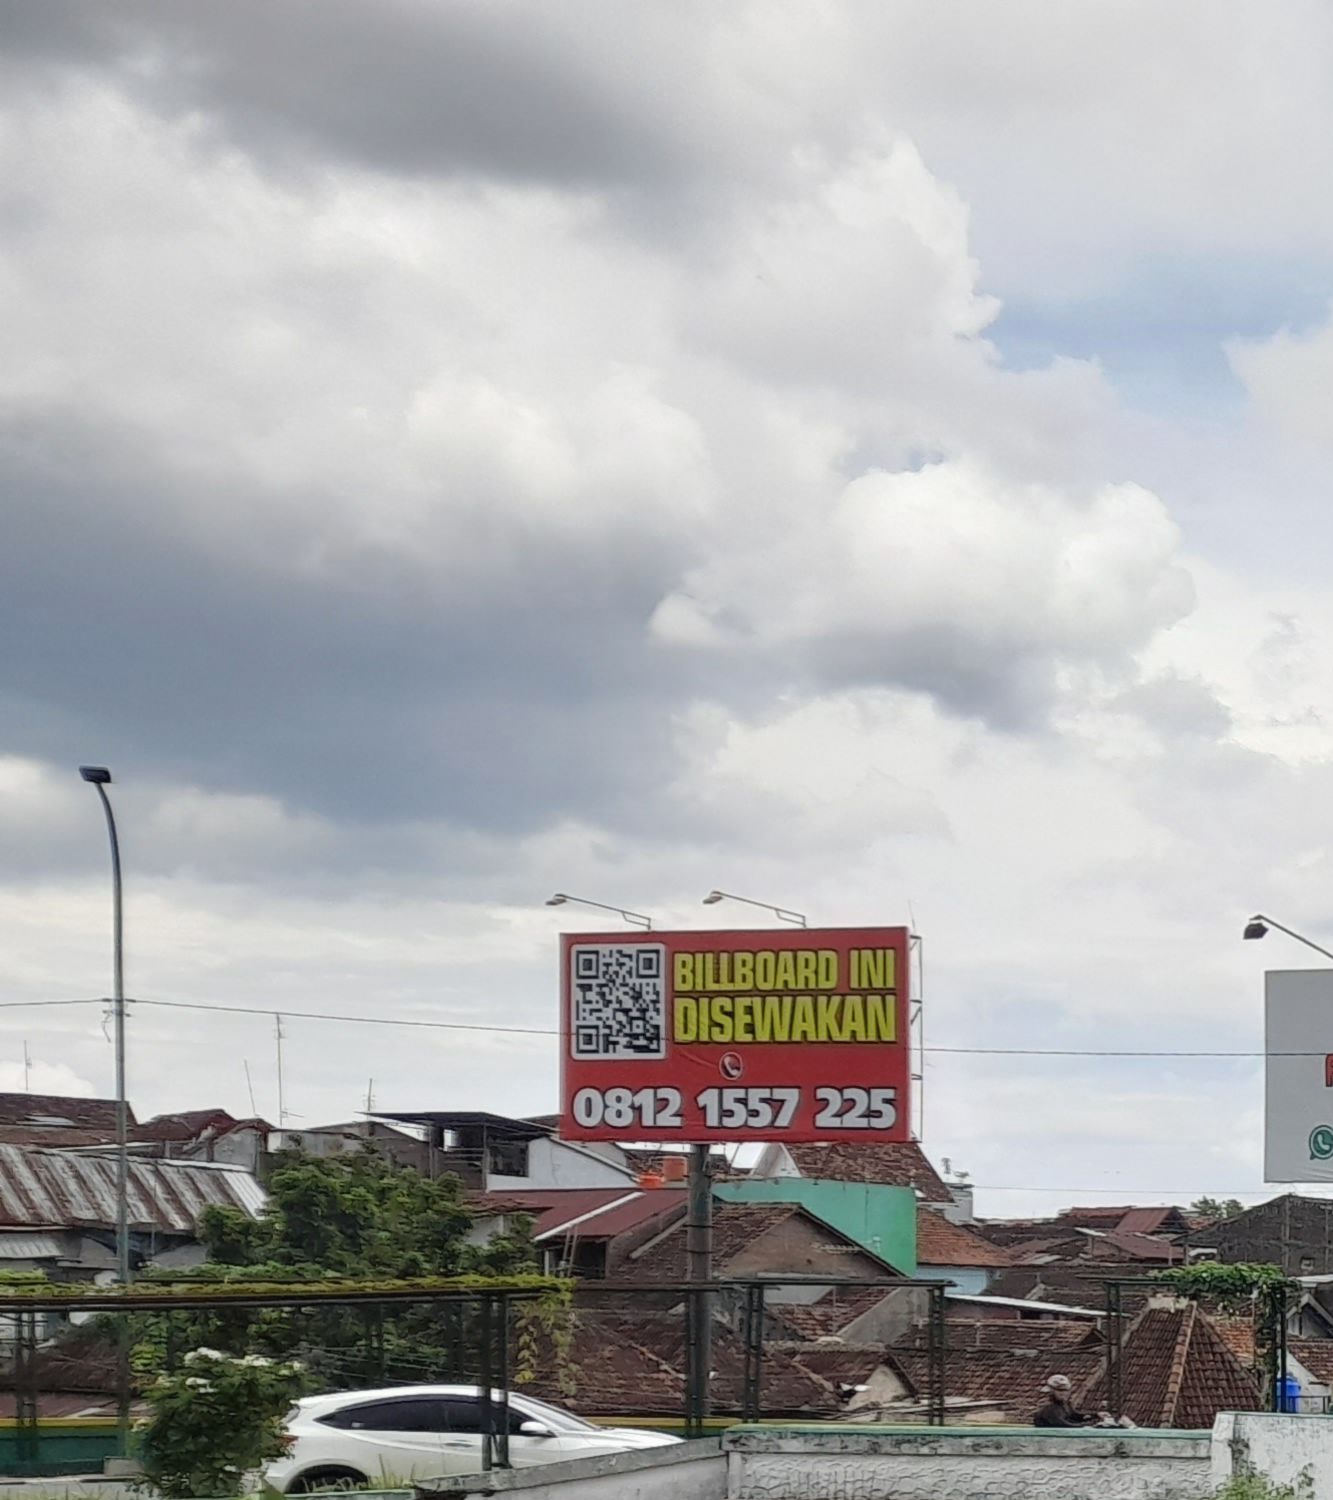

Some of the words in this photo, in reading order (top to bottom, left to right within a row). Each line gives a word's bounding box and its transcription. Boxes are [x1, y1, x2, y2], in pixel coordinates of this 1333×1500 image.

[673, 949, 838, 992] BILLBOARD
[849, 948, 896, 989] INI
[673, 995, 896, 1043] DISEWAKAN
[573, 1087, 683, 1128] 0812
[697, 1087, 800, 1128] 1557
[815, 1087, 897, 1129] 225
